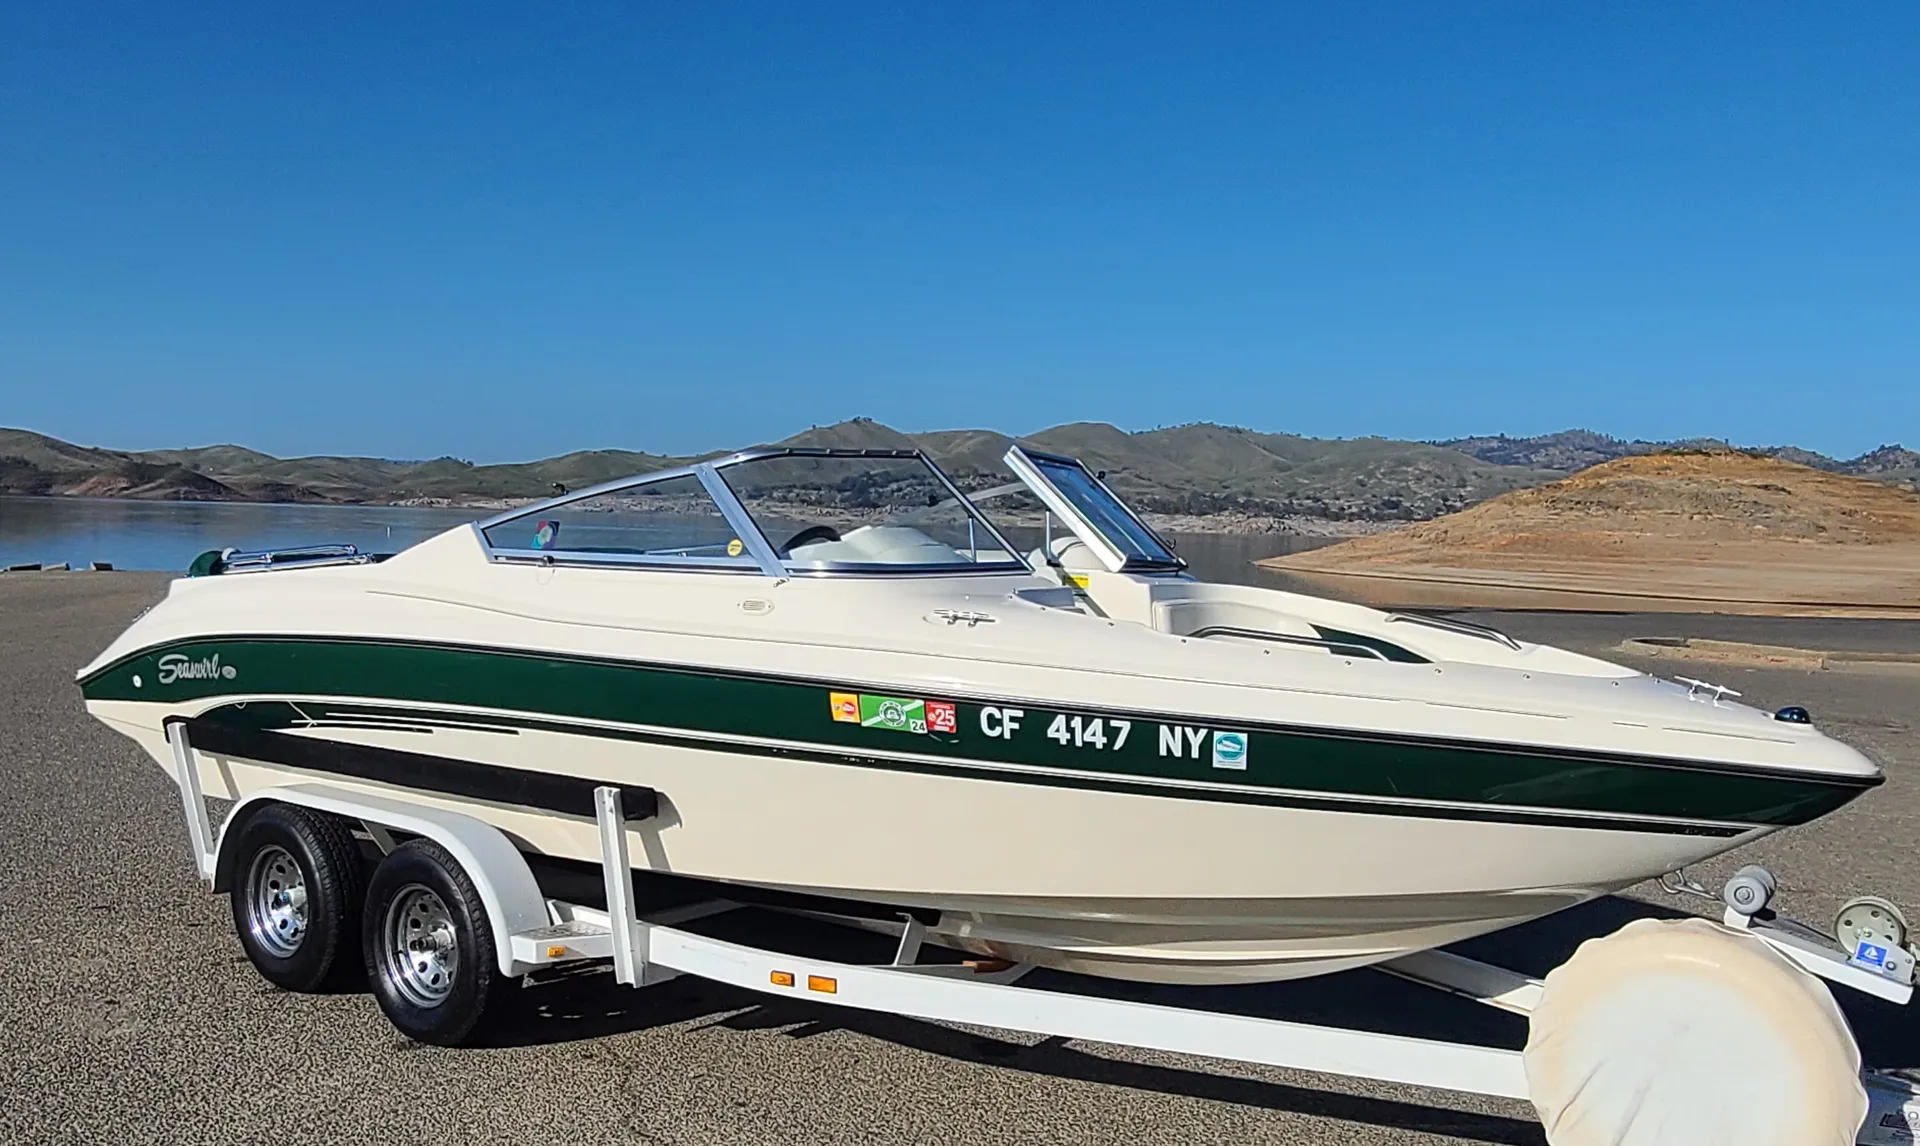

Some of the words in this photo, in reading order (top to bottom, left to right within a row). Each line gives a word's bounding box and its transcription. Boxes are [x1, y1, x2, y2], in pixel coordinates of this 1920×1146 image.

[911, 720, 926, 732] 24
[935, 708, 955, 726] 25
[980, 706, 1024, 739] CF
[1047, 714, 1131, 750] 4147
[1159, 725, 1208, 759] NY
